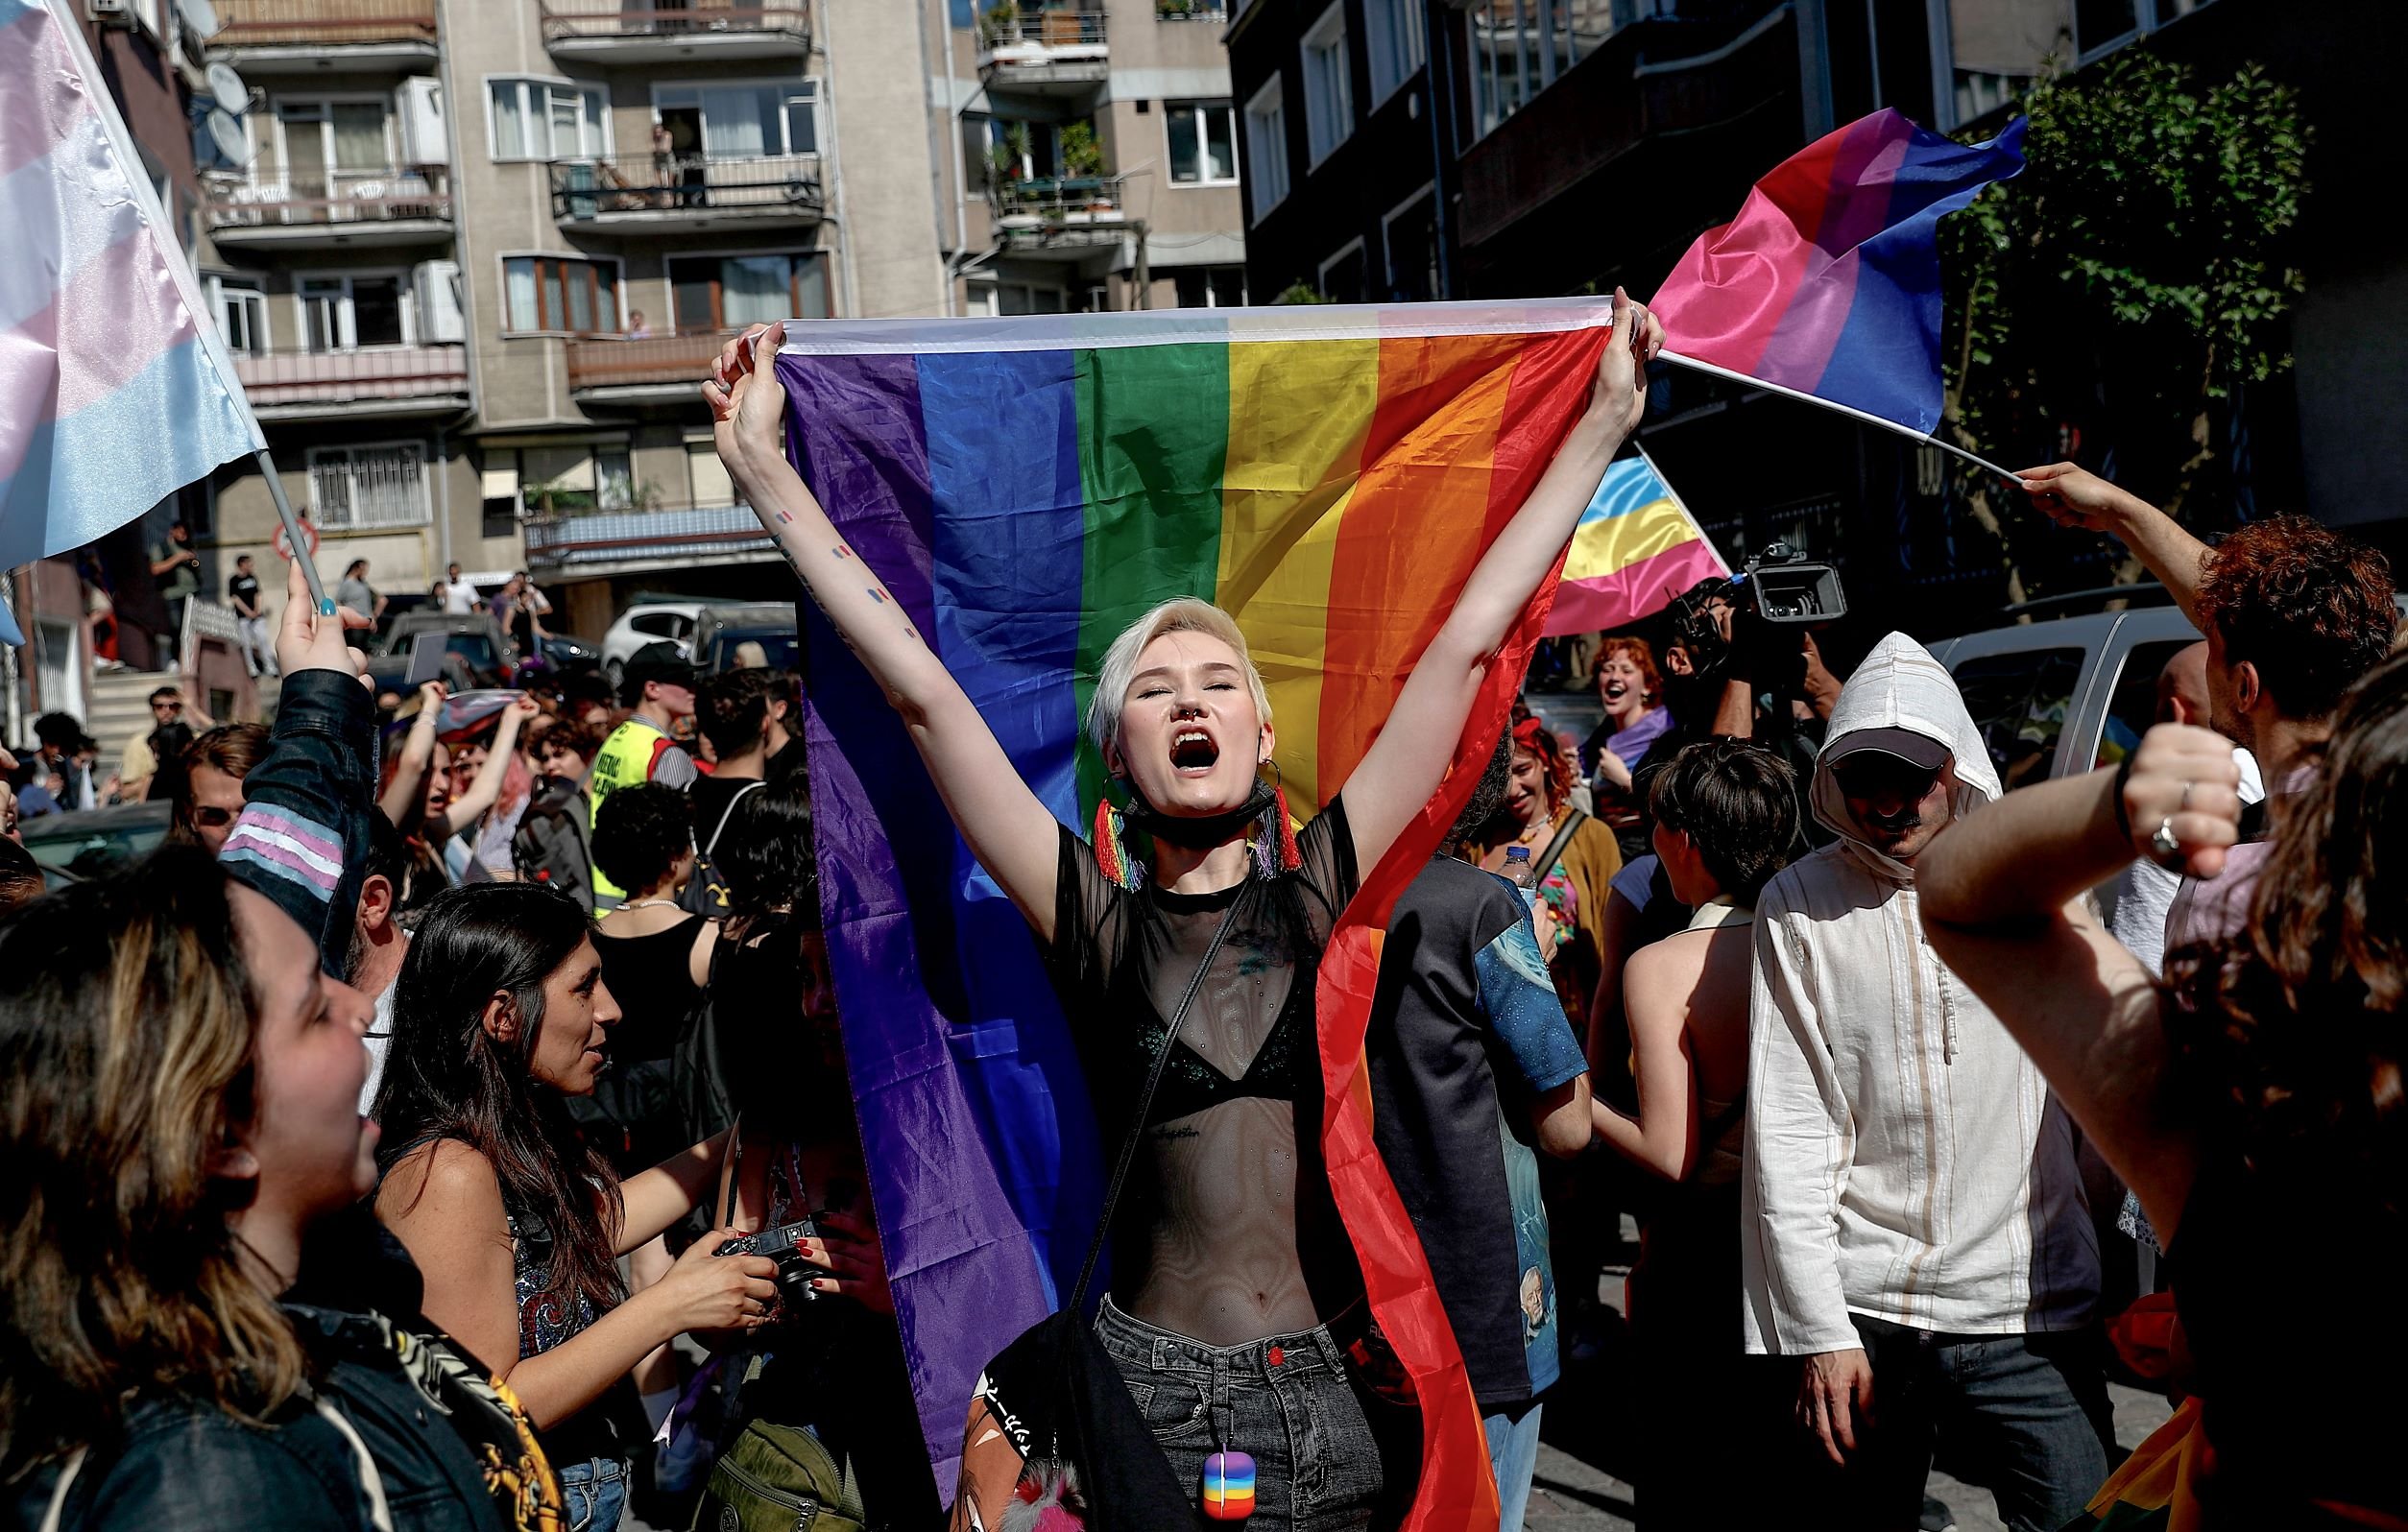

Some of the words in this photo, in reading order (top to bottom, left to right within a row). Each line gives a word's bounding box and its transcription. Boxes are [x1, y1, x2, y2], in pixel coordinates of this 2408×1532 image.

[986, 1377, 1031, 1458] アッカーマ
